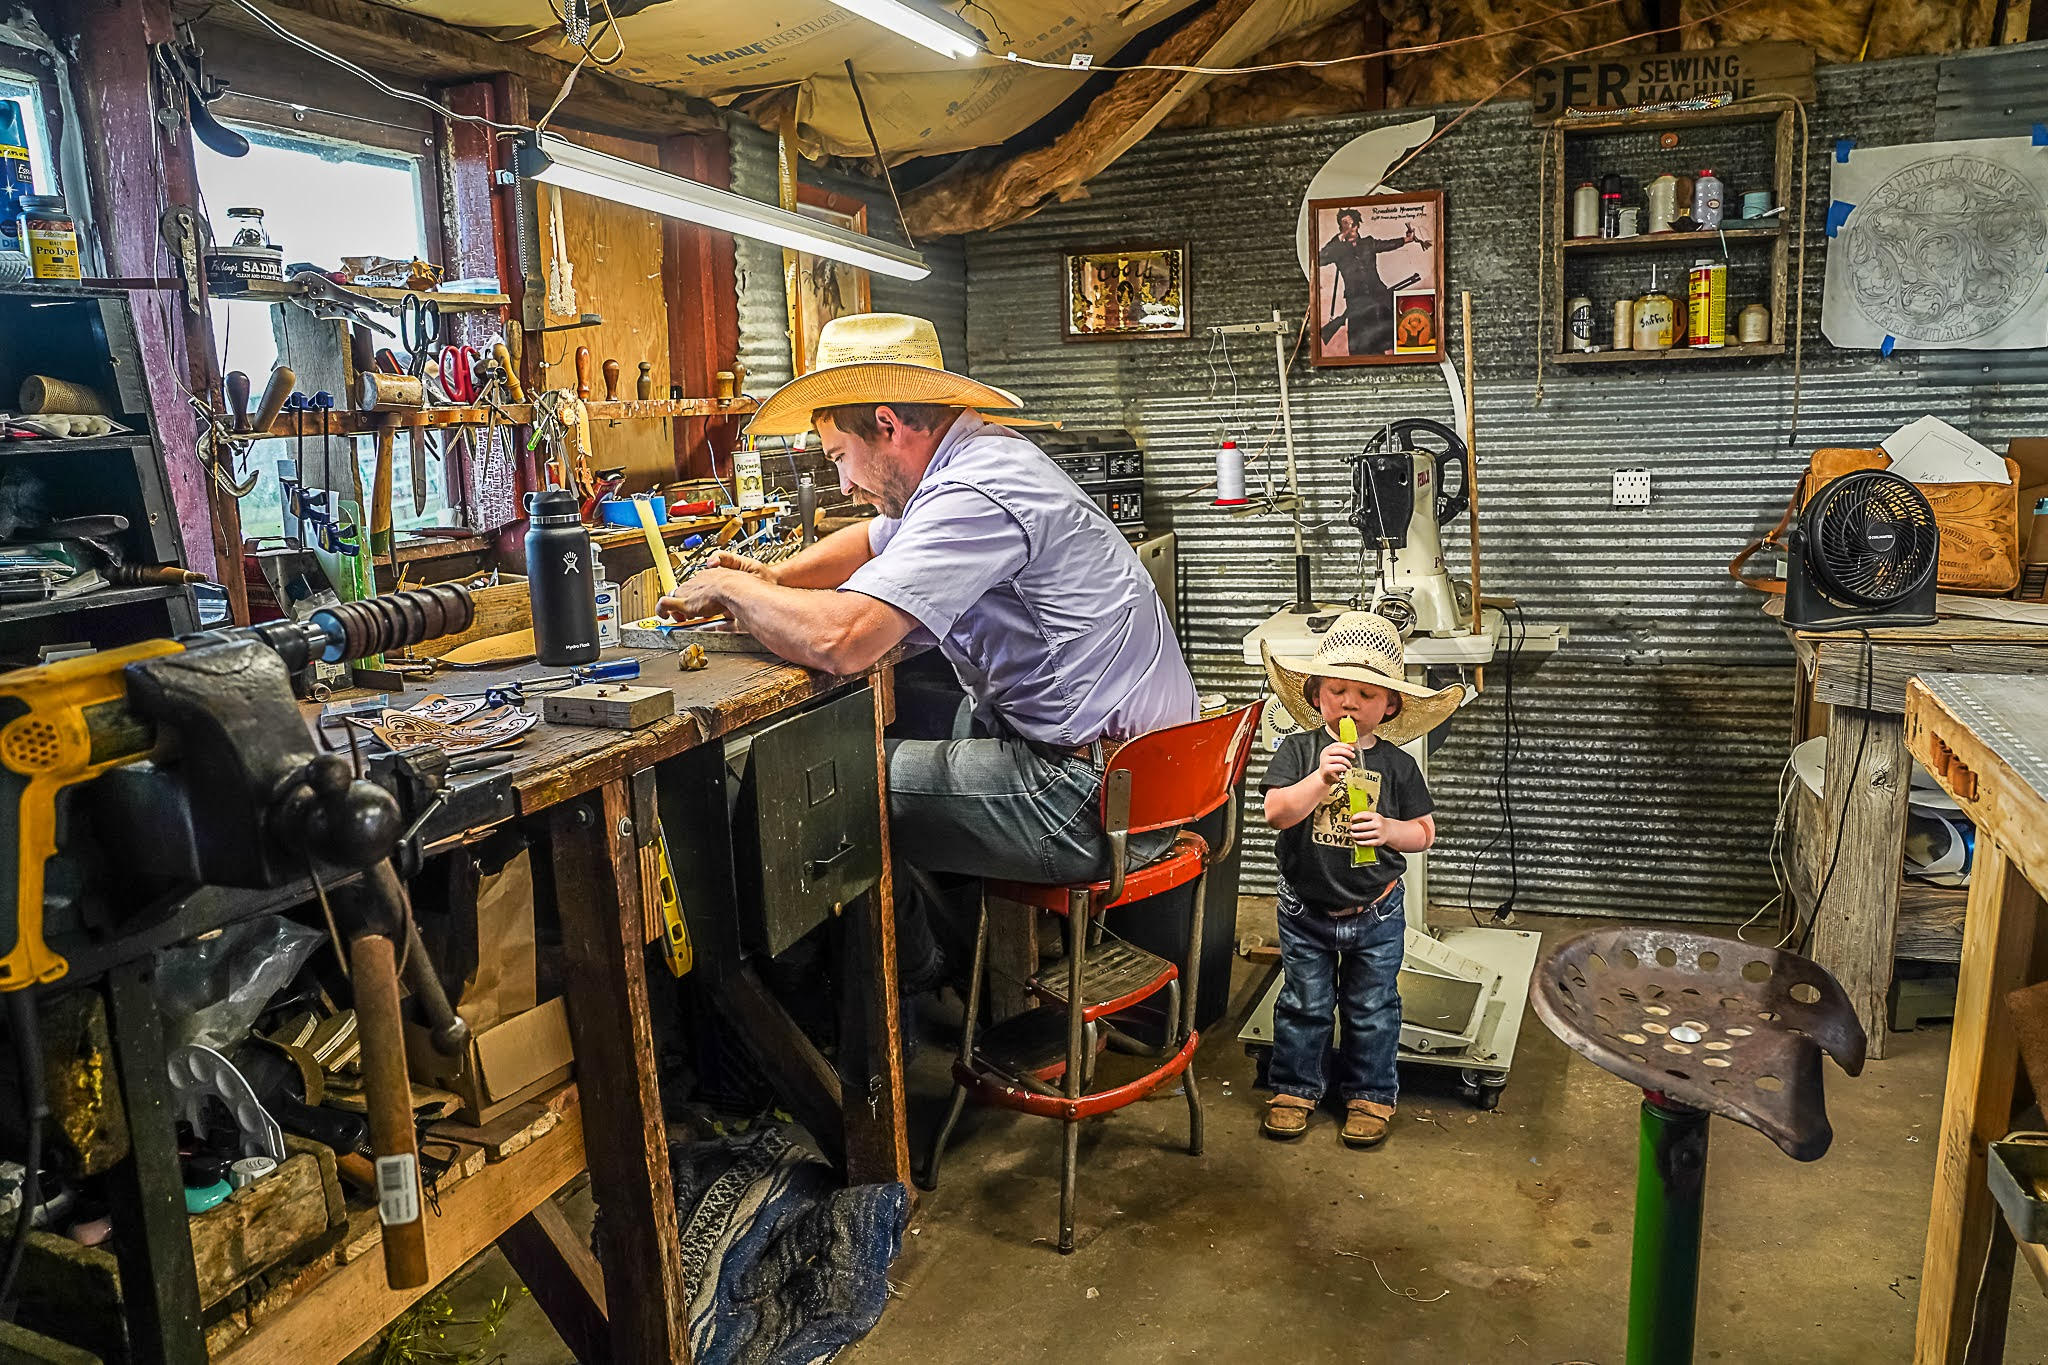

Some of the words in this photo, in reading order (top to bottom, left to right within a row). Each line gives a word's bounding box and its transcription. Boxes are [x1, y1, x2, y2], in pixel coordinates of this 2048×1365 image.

[687, 42, 768, 66] KNAUF
[1638, 54, 1740, 83] SEWING
[37, 246, 55, 255] Pro
[56, 247, 75, 257] Dye
[565, 643, 579, 651] Hydro
